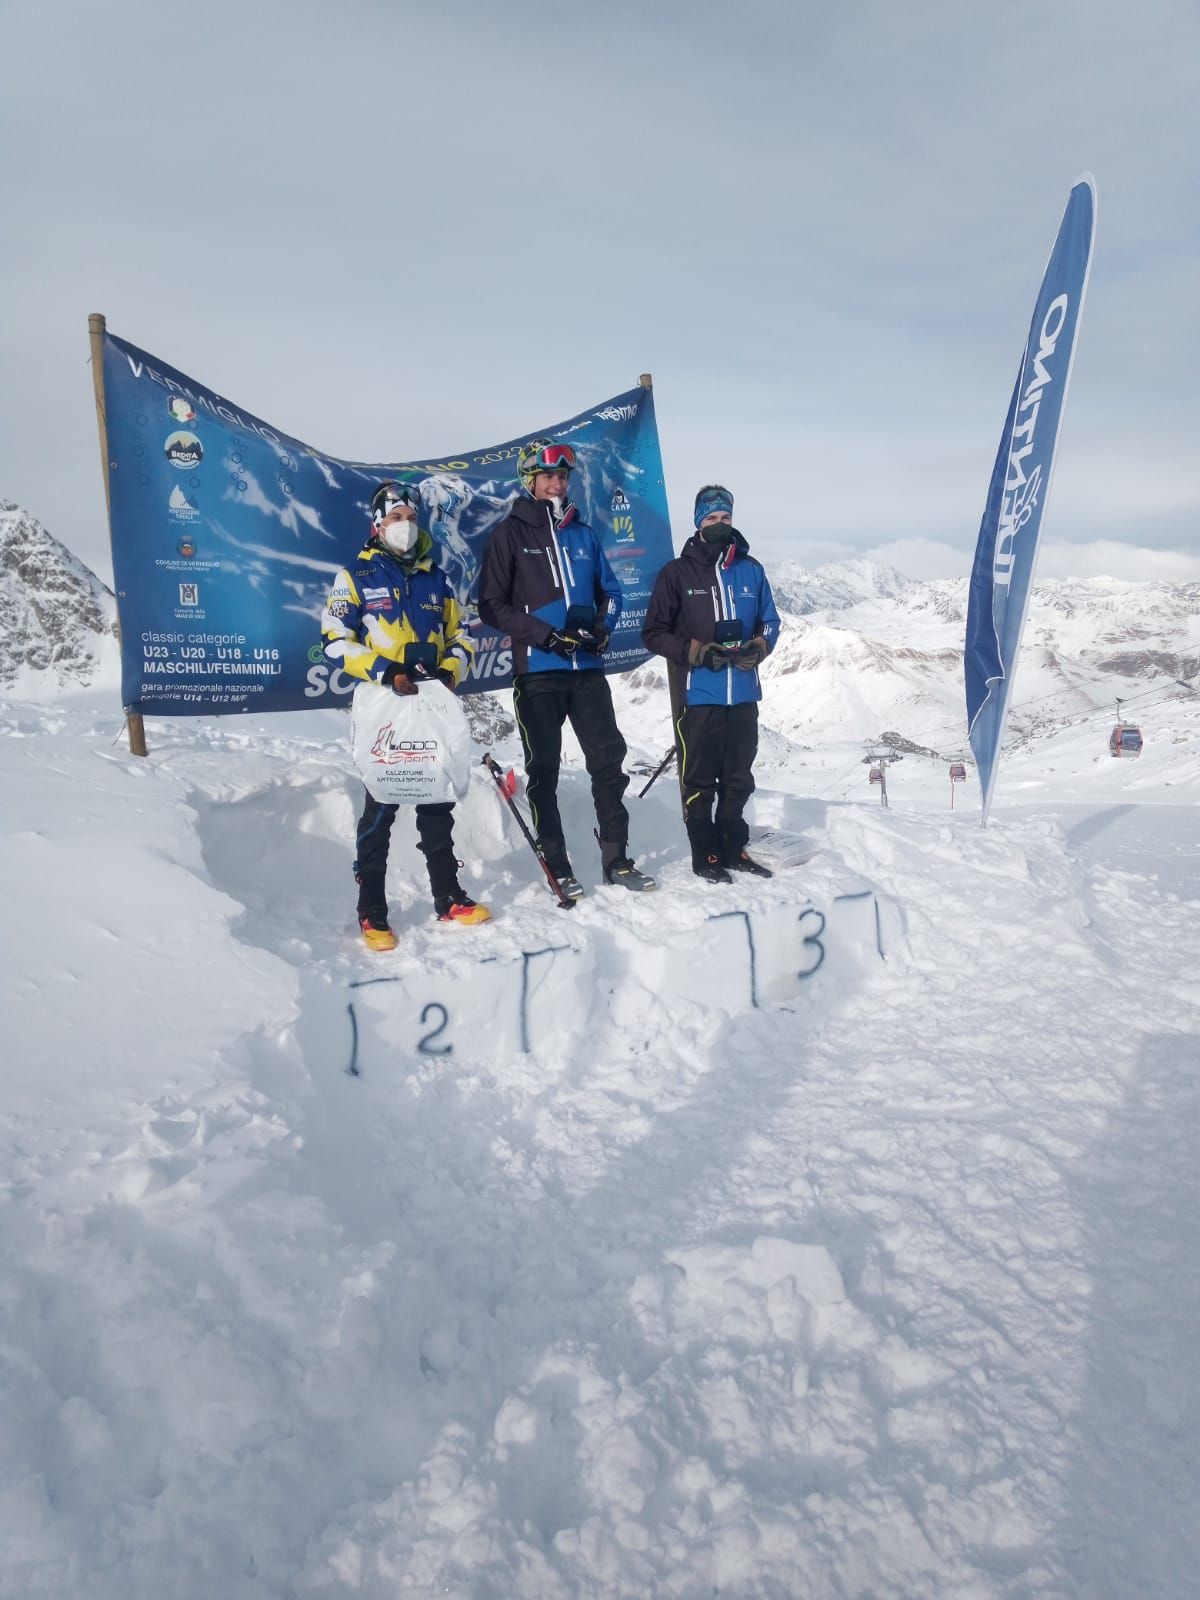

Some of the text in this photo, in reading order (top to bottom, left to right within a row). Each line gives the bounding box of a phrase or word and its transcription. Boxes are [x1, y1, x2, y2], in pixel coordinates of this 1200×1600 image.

[622, 619, 641, 628] SOLE
[141, 631, 246, 646] classic categorie
[143, 646, 169, 658] U23
[181, 647, 206, 659] U20
[217, 648, 241, 660] U18
[253, 649, 279, 660] U16
[143, 661, 282, 675] MASCHILI/FEMMINILI
[141, 683, 264, 693] gara promozionale nazionale
[184, 694, 201, 702] U14
[799, 910, 826, 979] 3
[417, 1002, 453, 1057] 2
